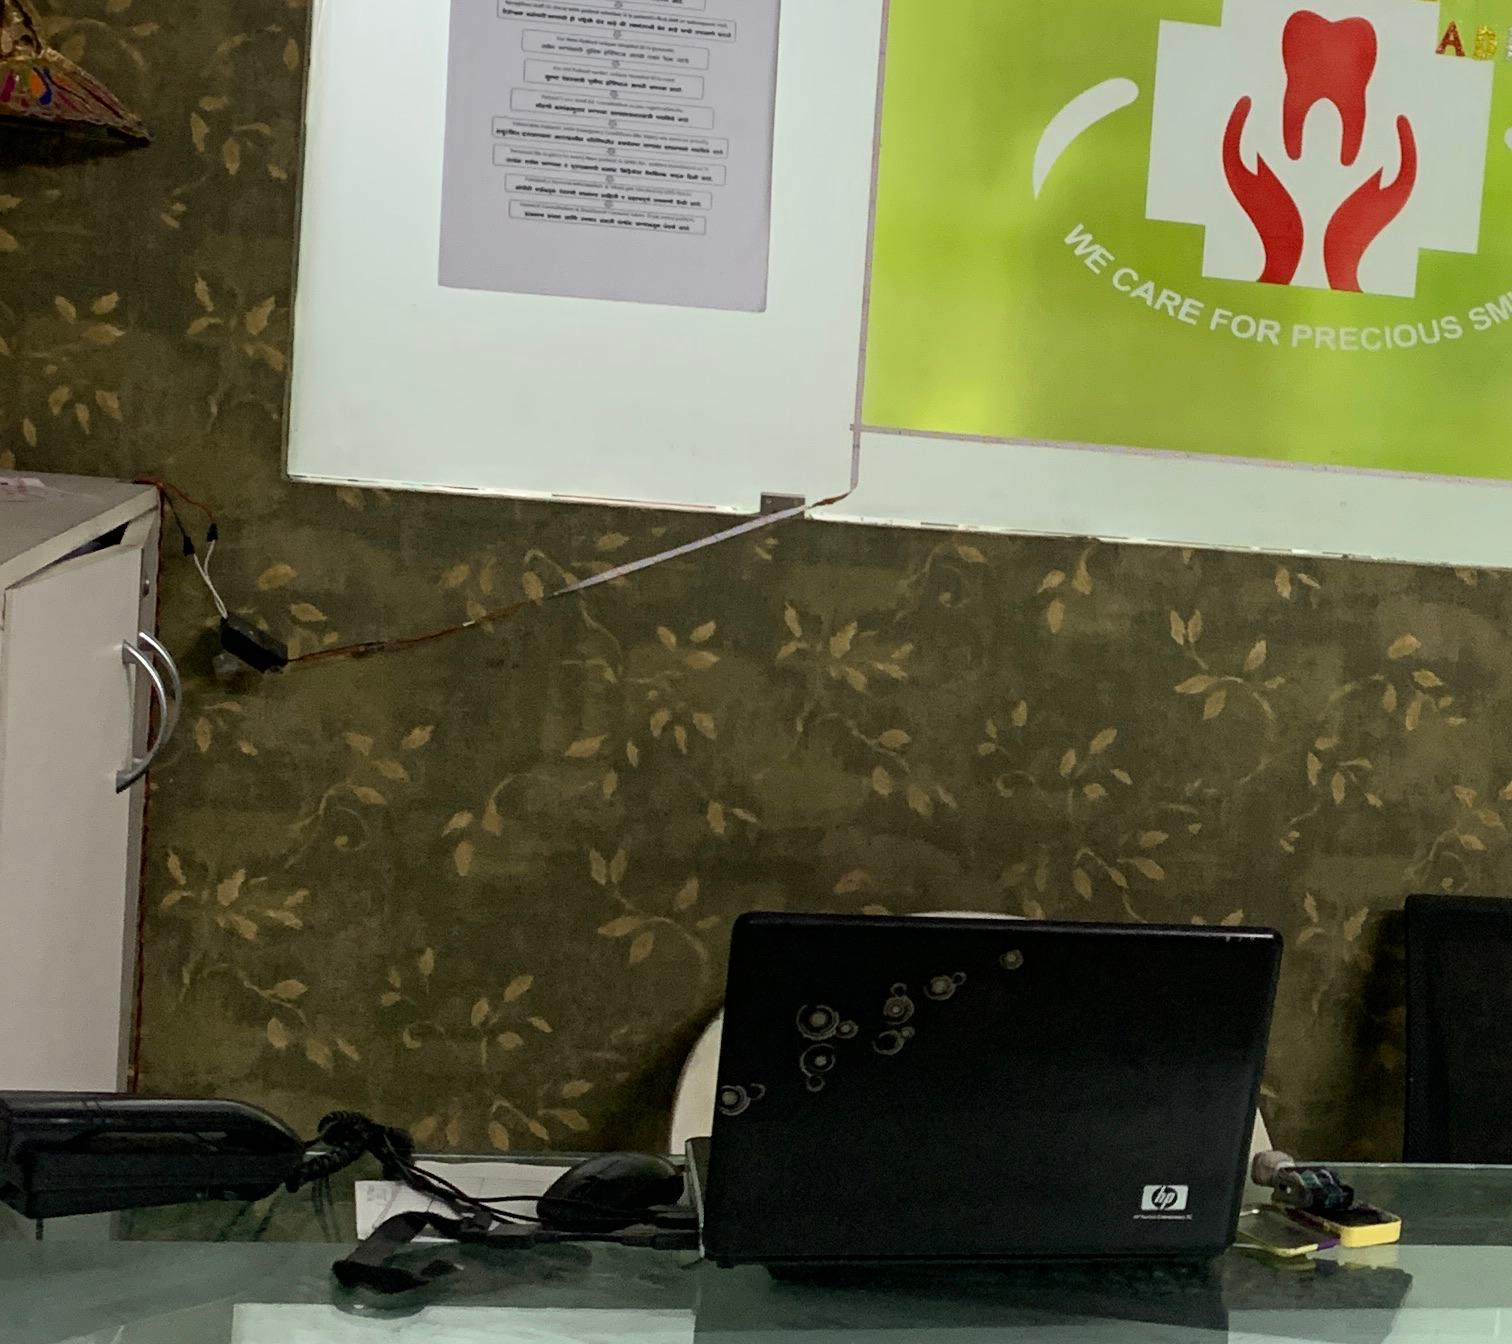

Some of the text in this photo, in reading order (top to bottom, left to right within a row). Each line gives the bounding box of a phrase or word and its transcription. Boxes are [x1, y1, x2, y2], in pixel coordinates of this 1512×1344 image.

[1062, 222, 1116, 274] WE
[1112, 266, 1204, 326] CARE
[1209, 307, 1282, 345] FOR
[1291, 315, 1464, 351] PRECIOUS
